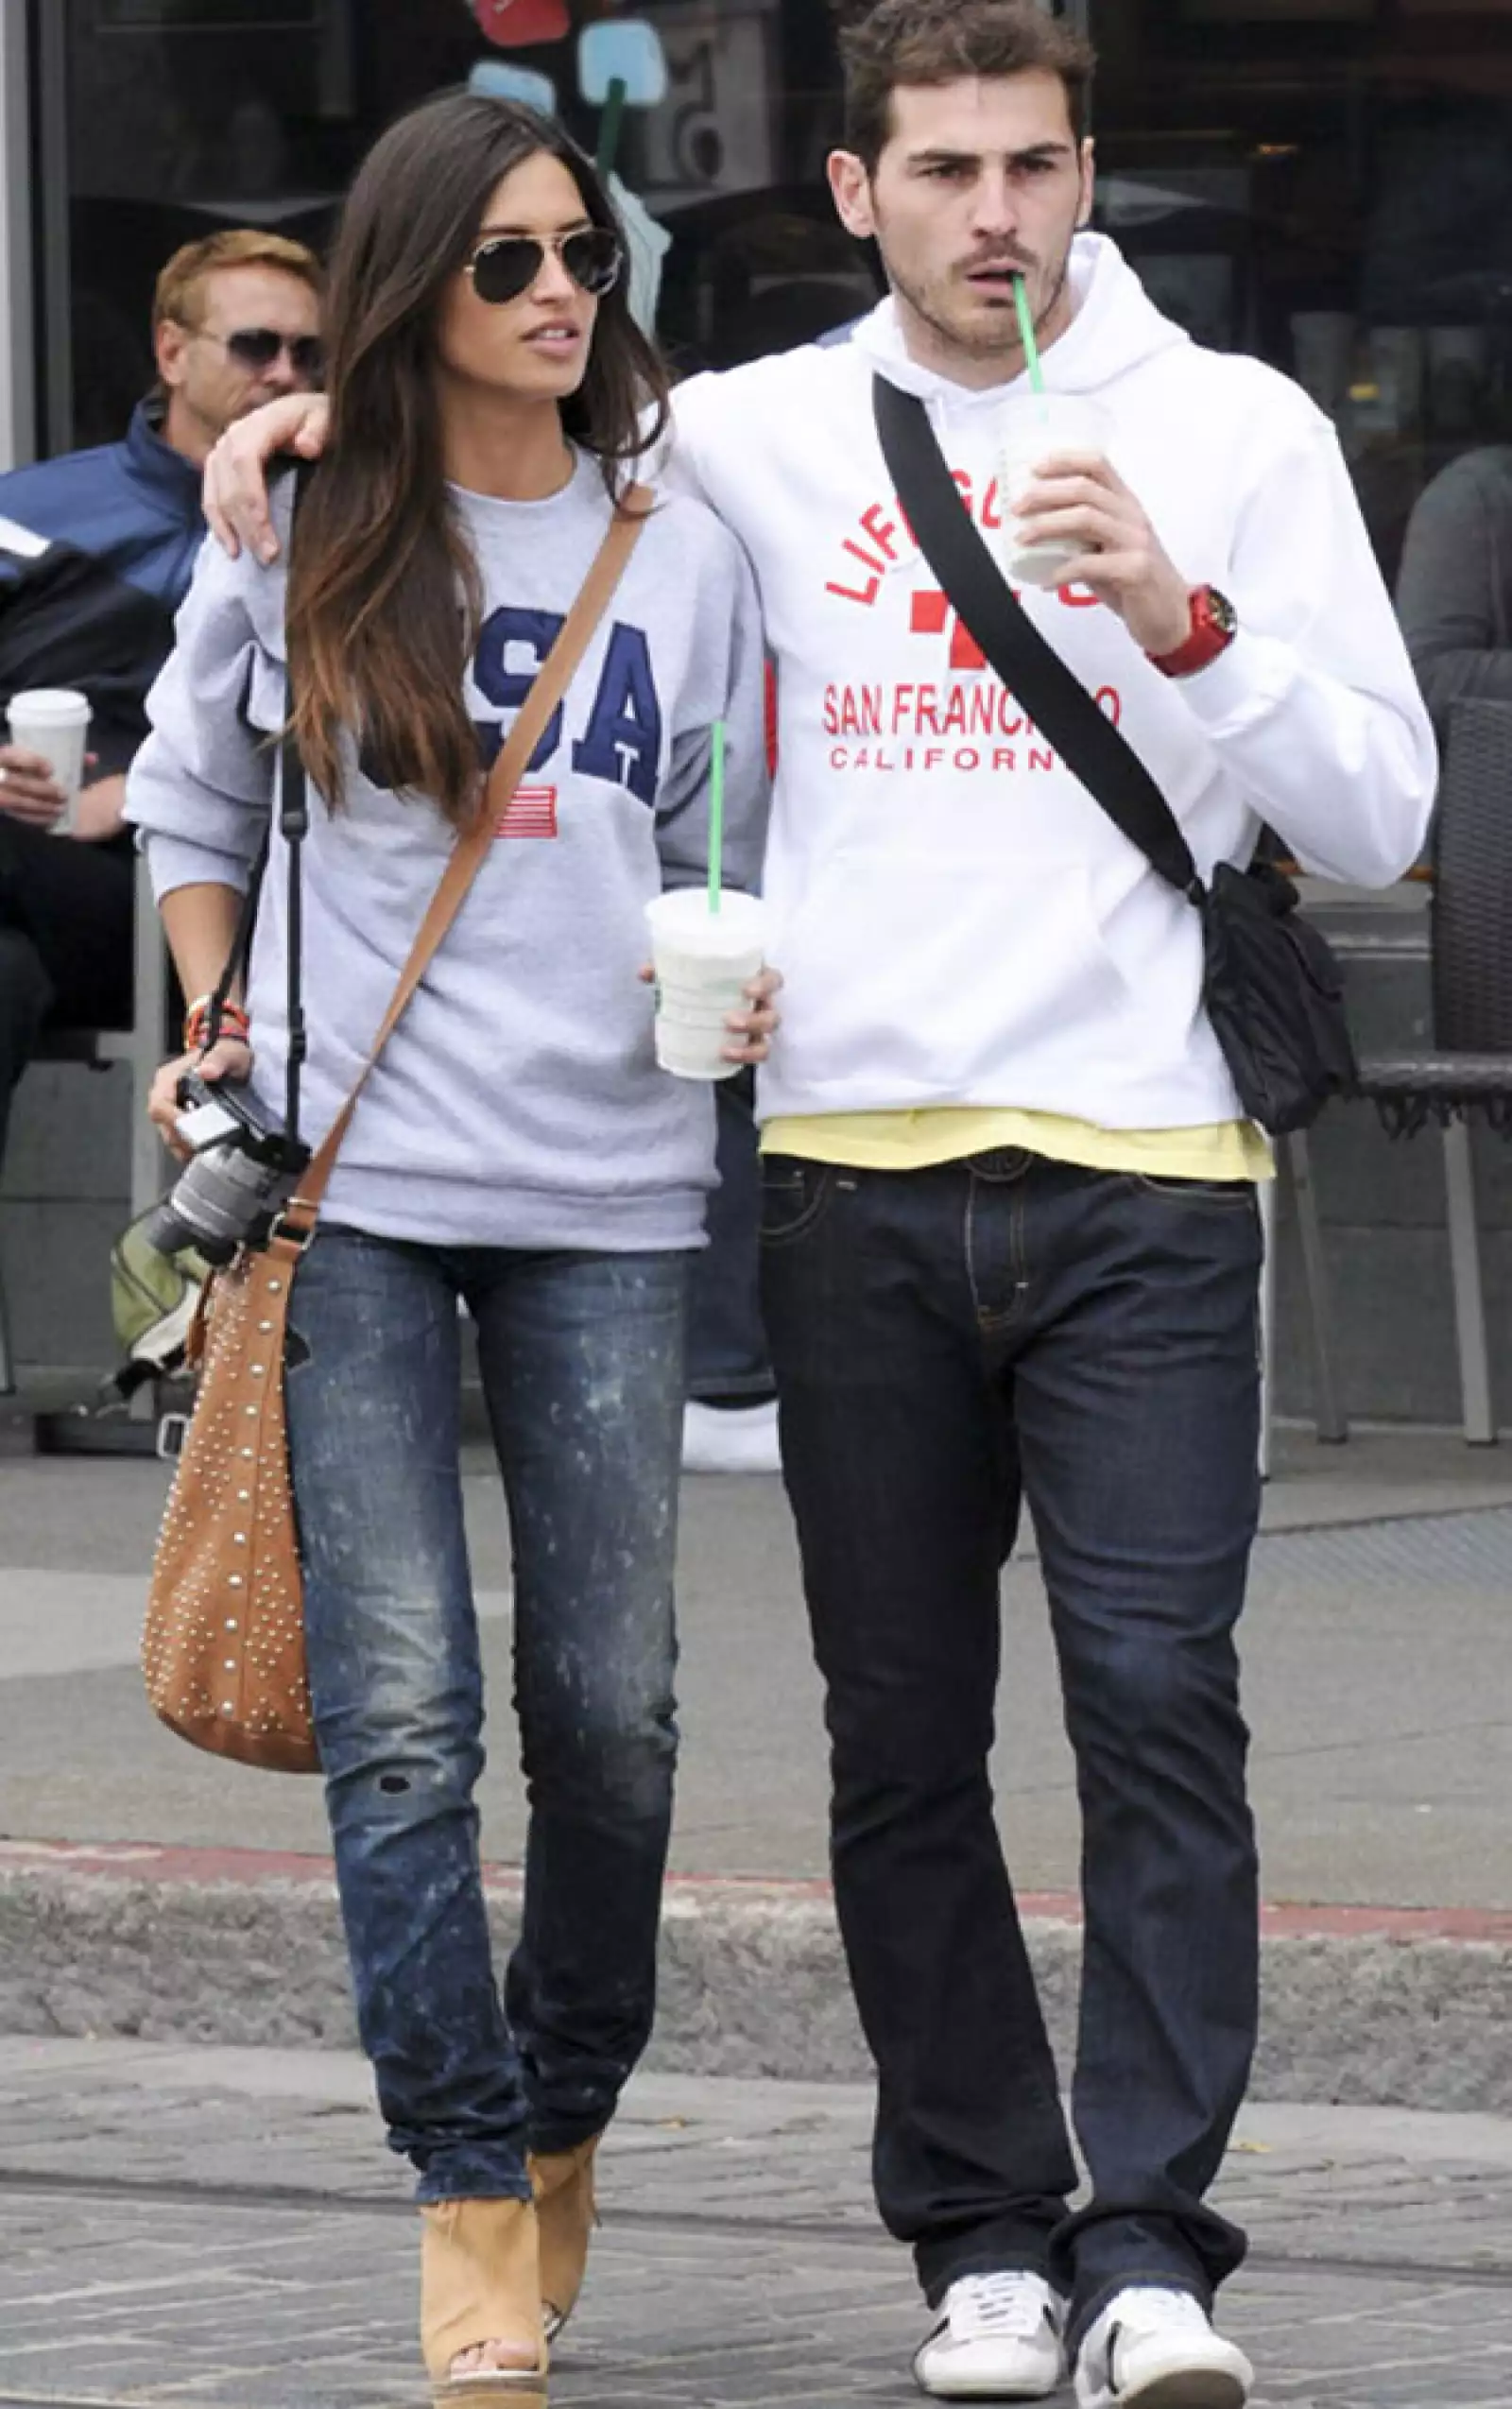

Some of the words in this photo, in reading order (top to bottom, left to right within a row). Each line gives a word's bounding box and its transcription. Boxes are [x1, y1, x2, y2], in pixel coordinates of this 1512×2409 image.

[359, 606, 661, 808] SA
[823, 683, 883, 736] SAN
[892, 683, 1122, 736] FRANCO
[830, 747, 1055, 771] CALIFORN
